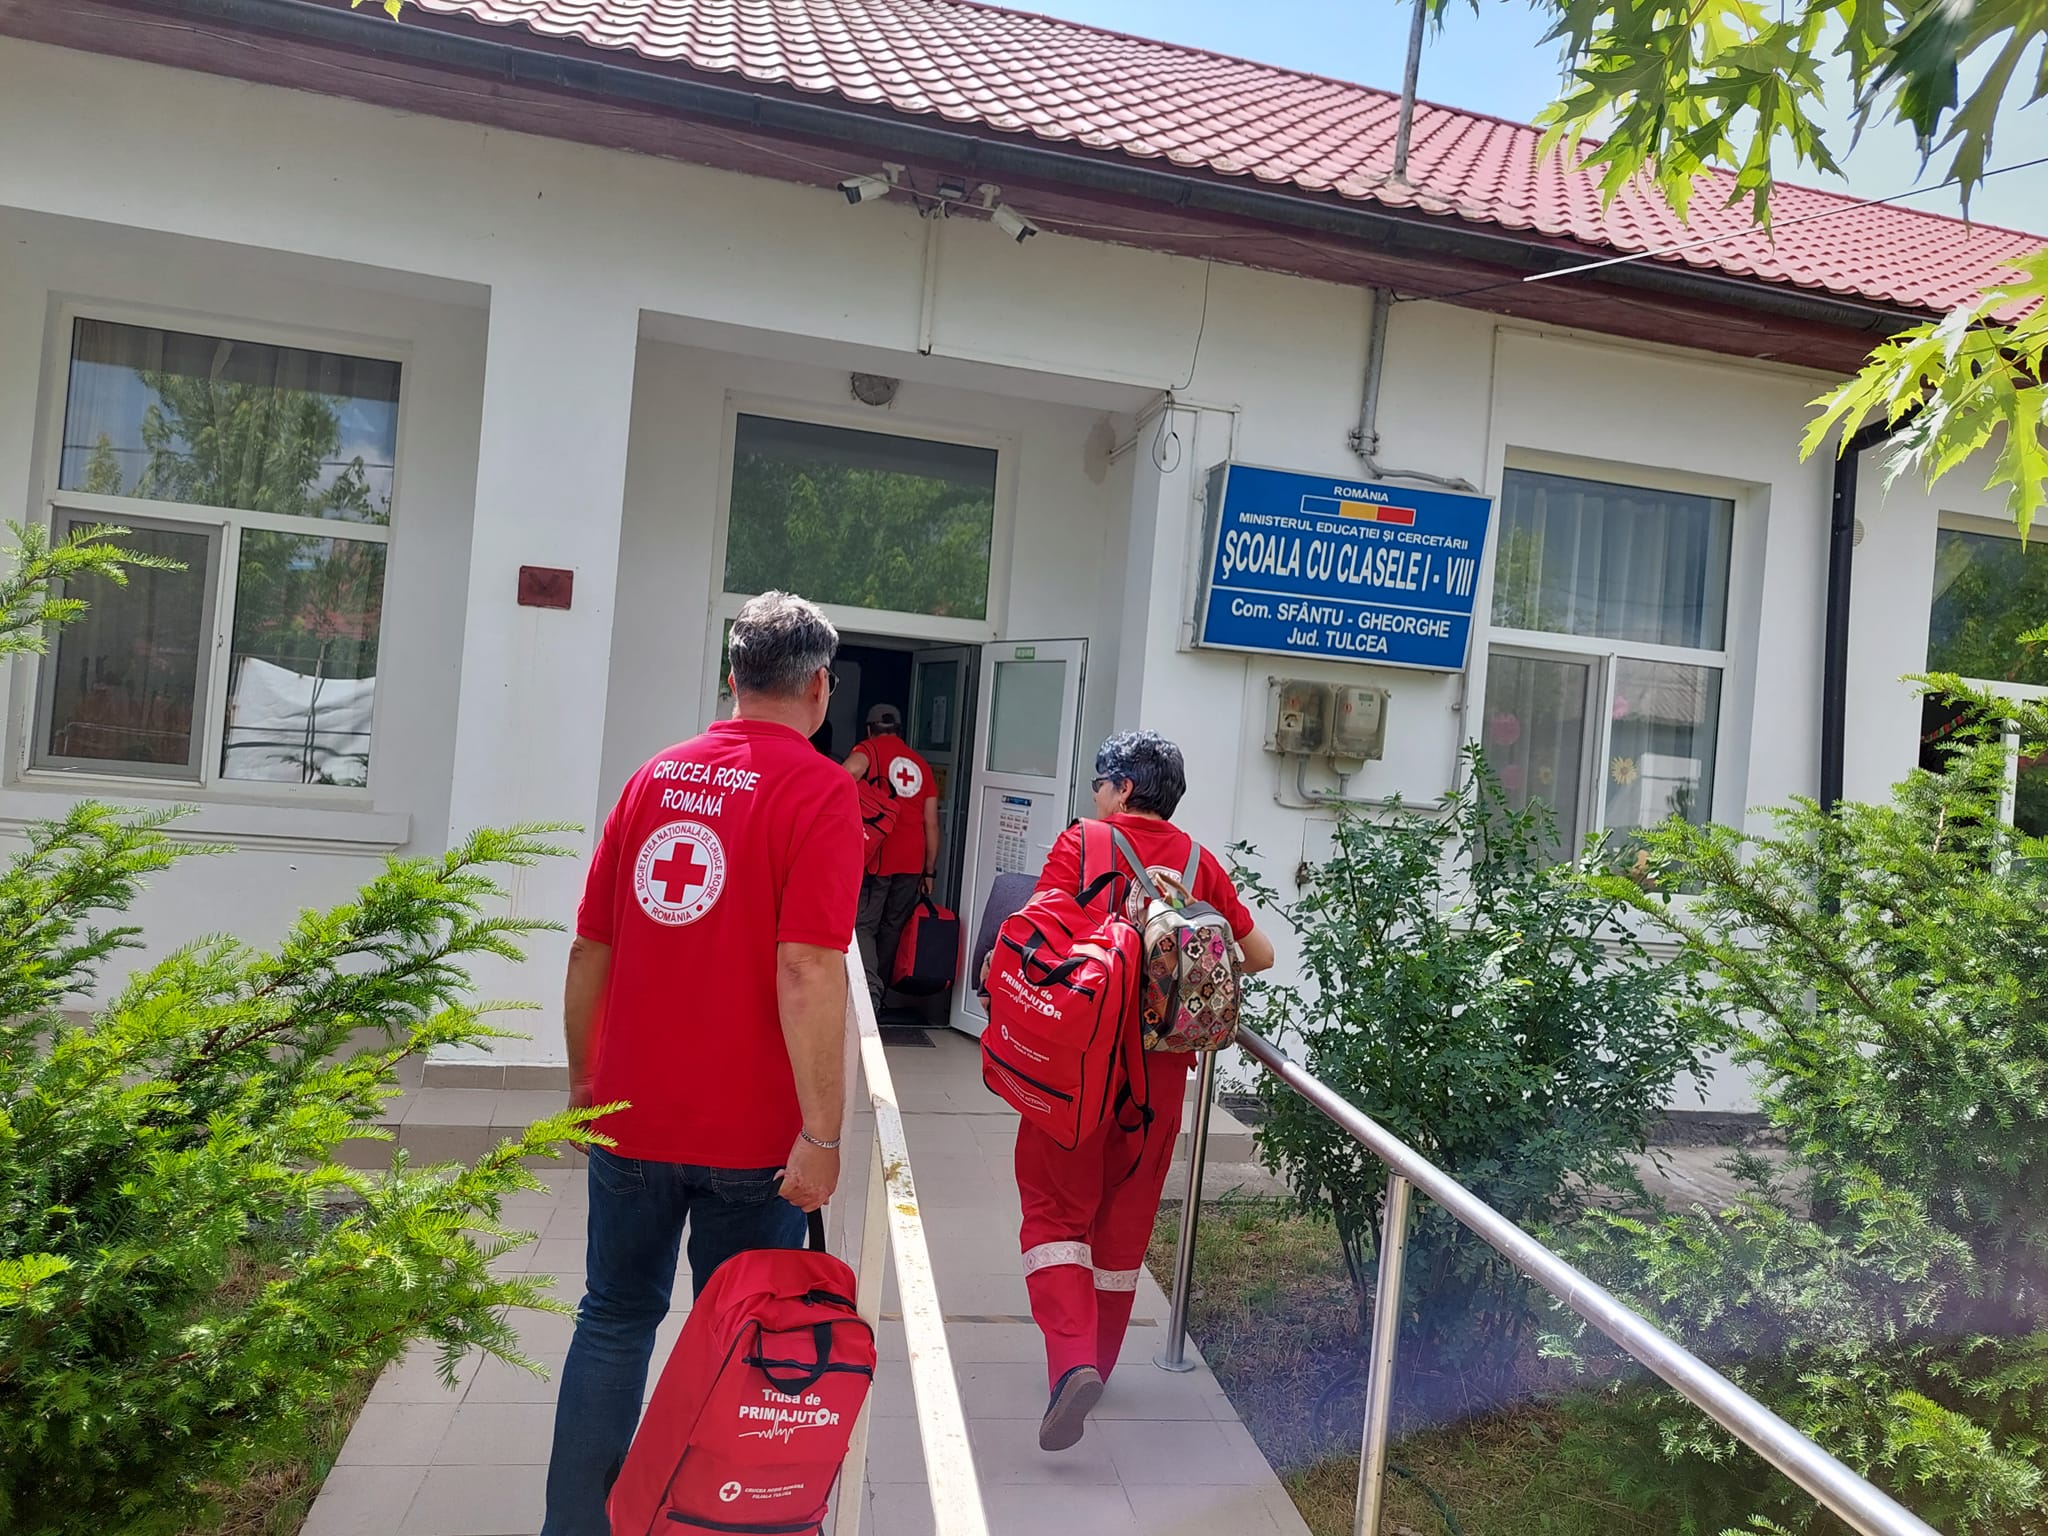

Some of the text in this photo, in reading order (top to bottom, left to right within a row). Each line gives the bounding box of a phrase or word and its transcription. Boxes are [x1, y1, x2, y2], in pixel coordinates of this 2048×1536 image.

[1334, 485, 1389, 502] ROMÂNIA
[1239, 512, 1313, 531] MINISTERUL
[1397, 532, 1469, 550] CERCETĂRII
[1306, 540, 1336, 581] CU
[1337, 543, 1422, 590] CLASELE
[1421, 554, 1432, 592] I
[1446, 556, 1475, 597] VIII
[1231, 598, 1272, 619] Com.
[1277, 602, 1344, 626] SFÂNTU
[1358, 612, 1450, 638] GHEORGHE
[1287, 628, 1388, 653] Jud. TULCEA
[653, 761, 712, 784] CRUCEA
[660, 788, 726, 817] ROMÂNĂ
[637, 840, 658, 891] SOCIETATEA
[701, 832, 712, 844] DE
[709, 842, 723, 872] CRUCE
[804, 1393, 821, 1406] de
